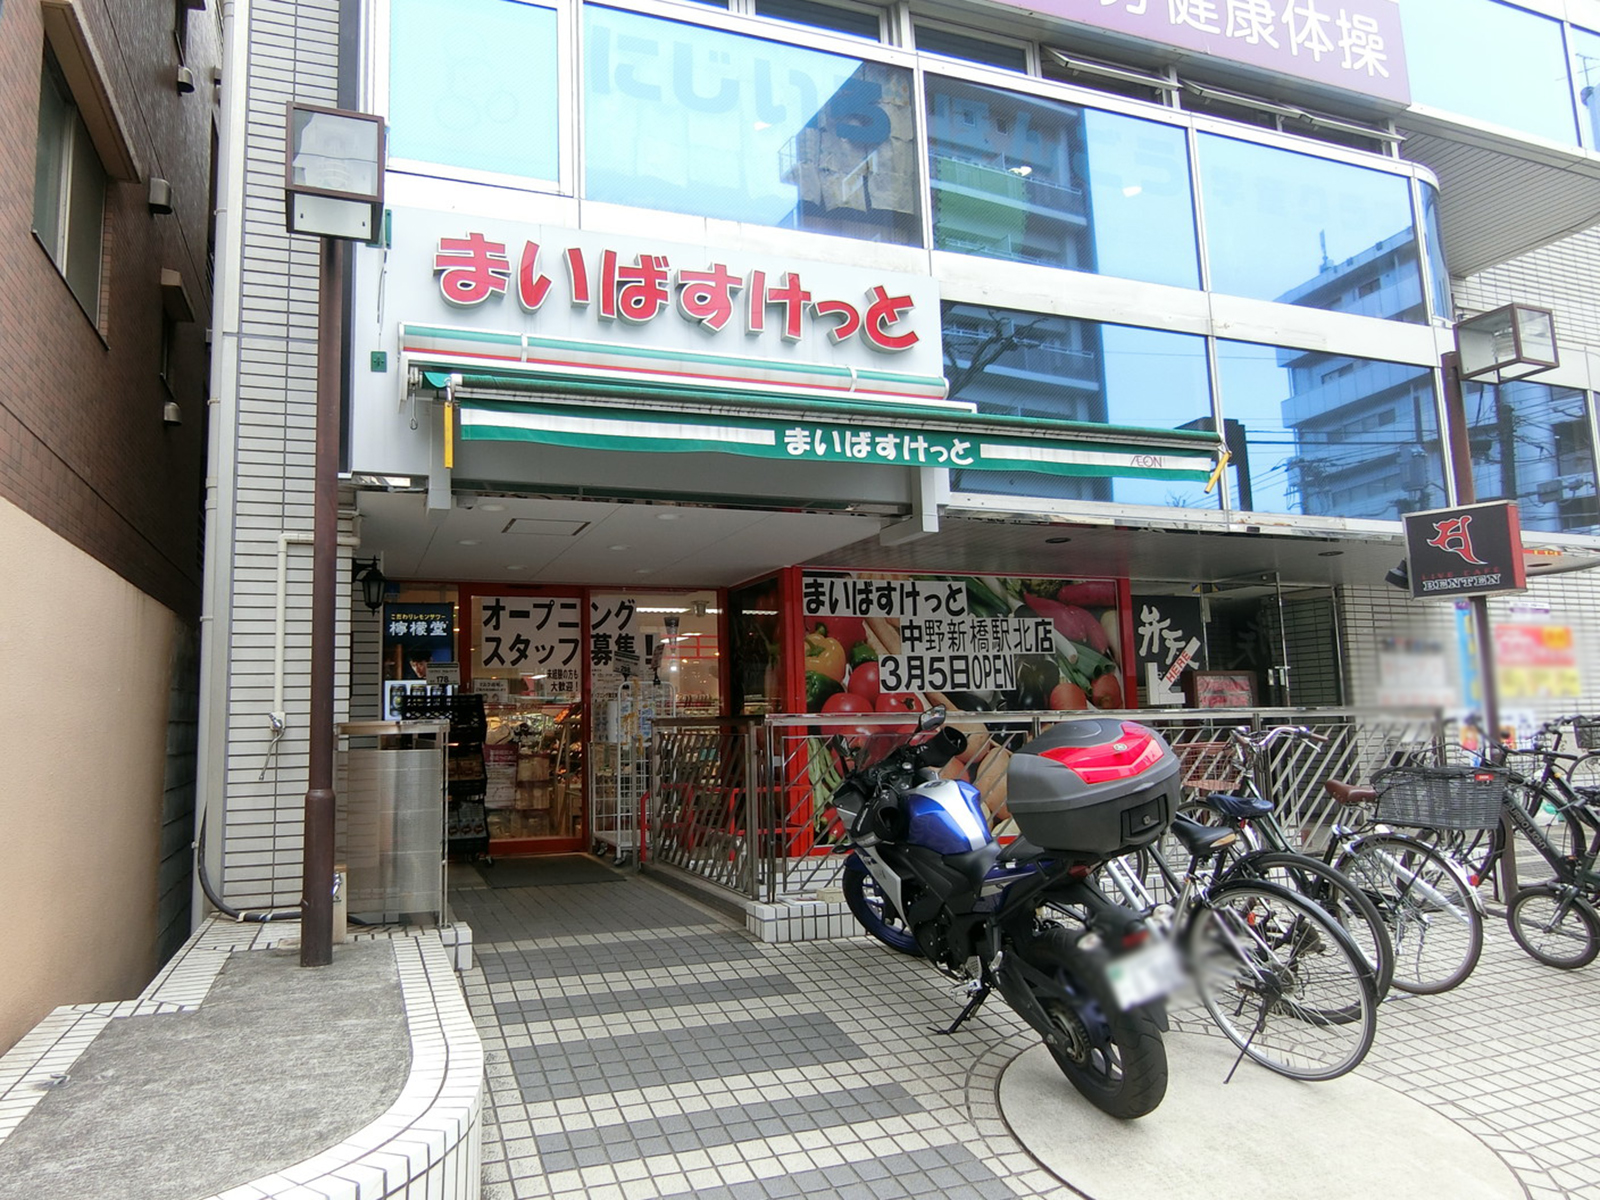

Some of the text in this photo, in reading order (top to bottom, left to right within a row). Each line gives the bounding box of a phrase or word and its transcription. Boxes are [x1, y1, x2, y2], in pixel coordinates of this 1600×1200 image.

[433, 231, 919, 354] まいばすけっと
[784, 427, 975, 466] まいばすけっと
[803, 578, 967, 617] まいばすけっと
[1423, 573, 1502, 592] BENTEN
[389, 621, 447, 636] 檸檬堂
[391, 613, 446, 621] こだわりレモンサワー
[483, 598, 635, 632] オープニング
[900, 618, 1054, 654] 中野新橋駅北店
[546, 669, 579, 680] 未経験の方も
[1166, 650, 1191, 683] HERE
